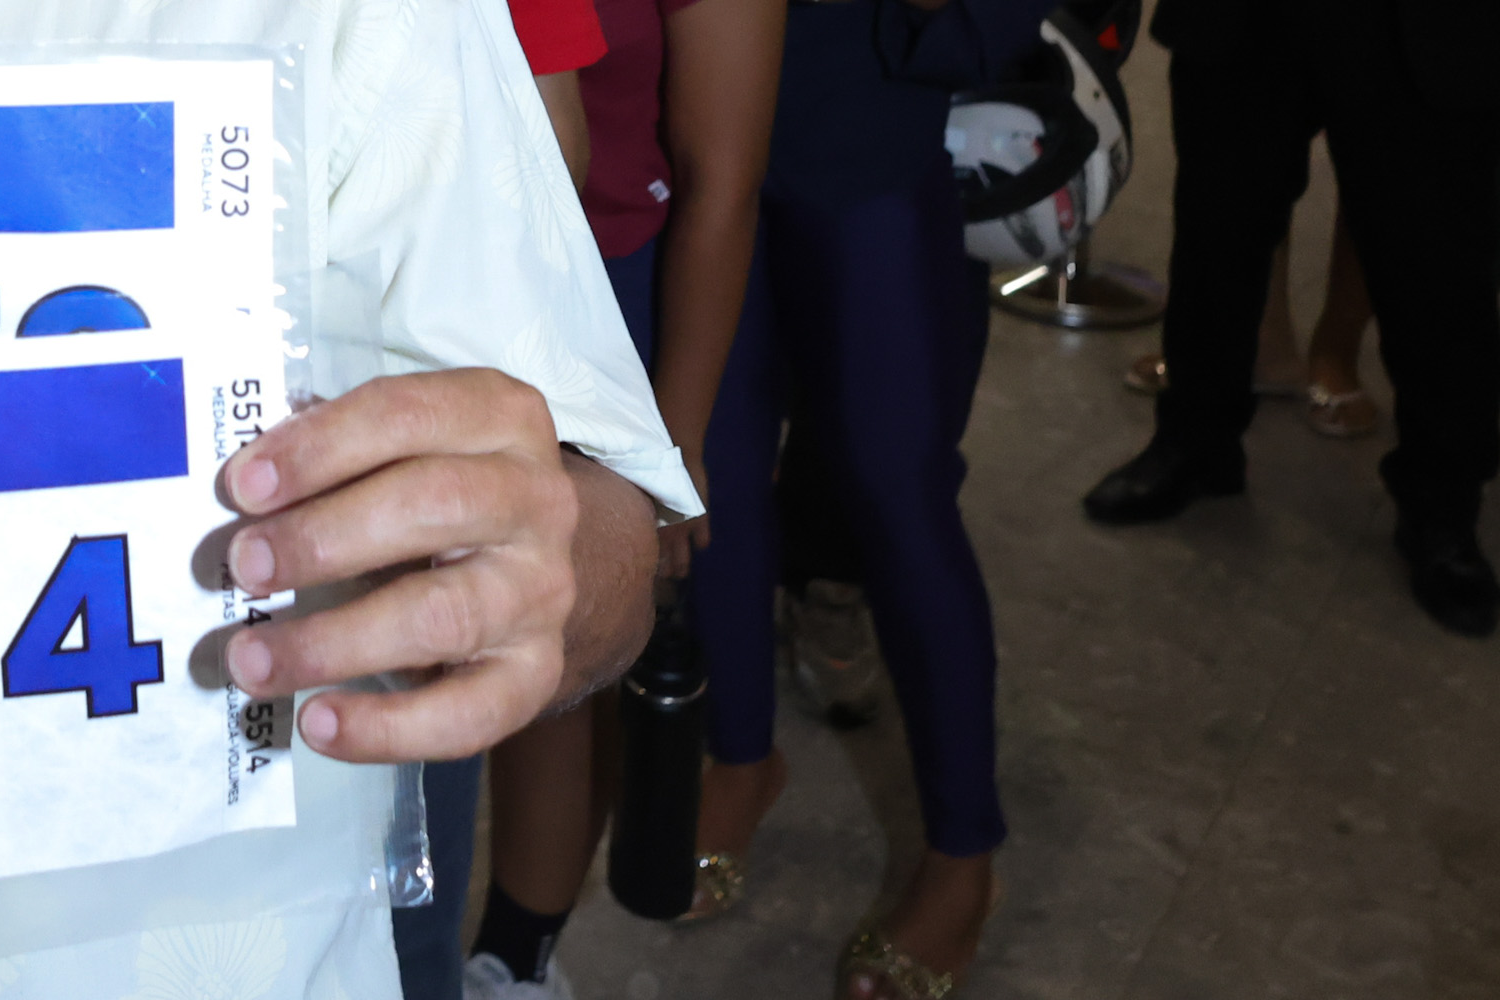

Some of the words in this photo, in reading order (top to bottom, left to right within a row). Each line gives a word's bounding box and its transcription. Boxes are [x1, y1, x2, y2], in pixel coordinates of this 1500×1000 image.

[201, 131, 214, 213] MEDALHA
[220, 124, 250, 218] 5073
[212, 385, 228, 461] MEDALHA
[243, 702, 274, 775] 5514
